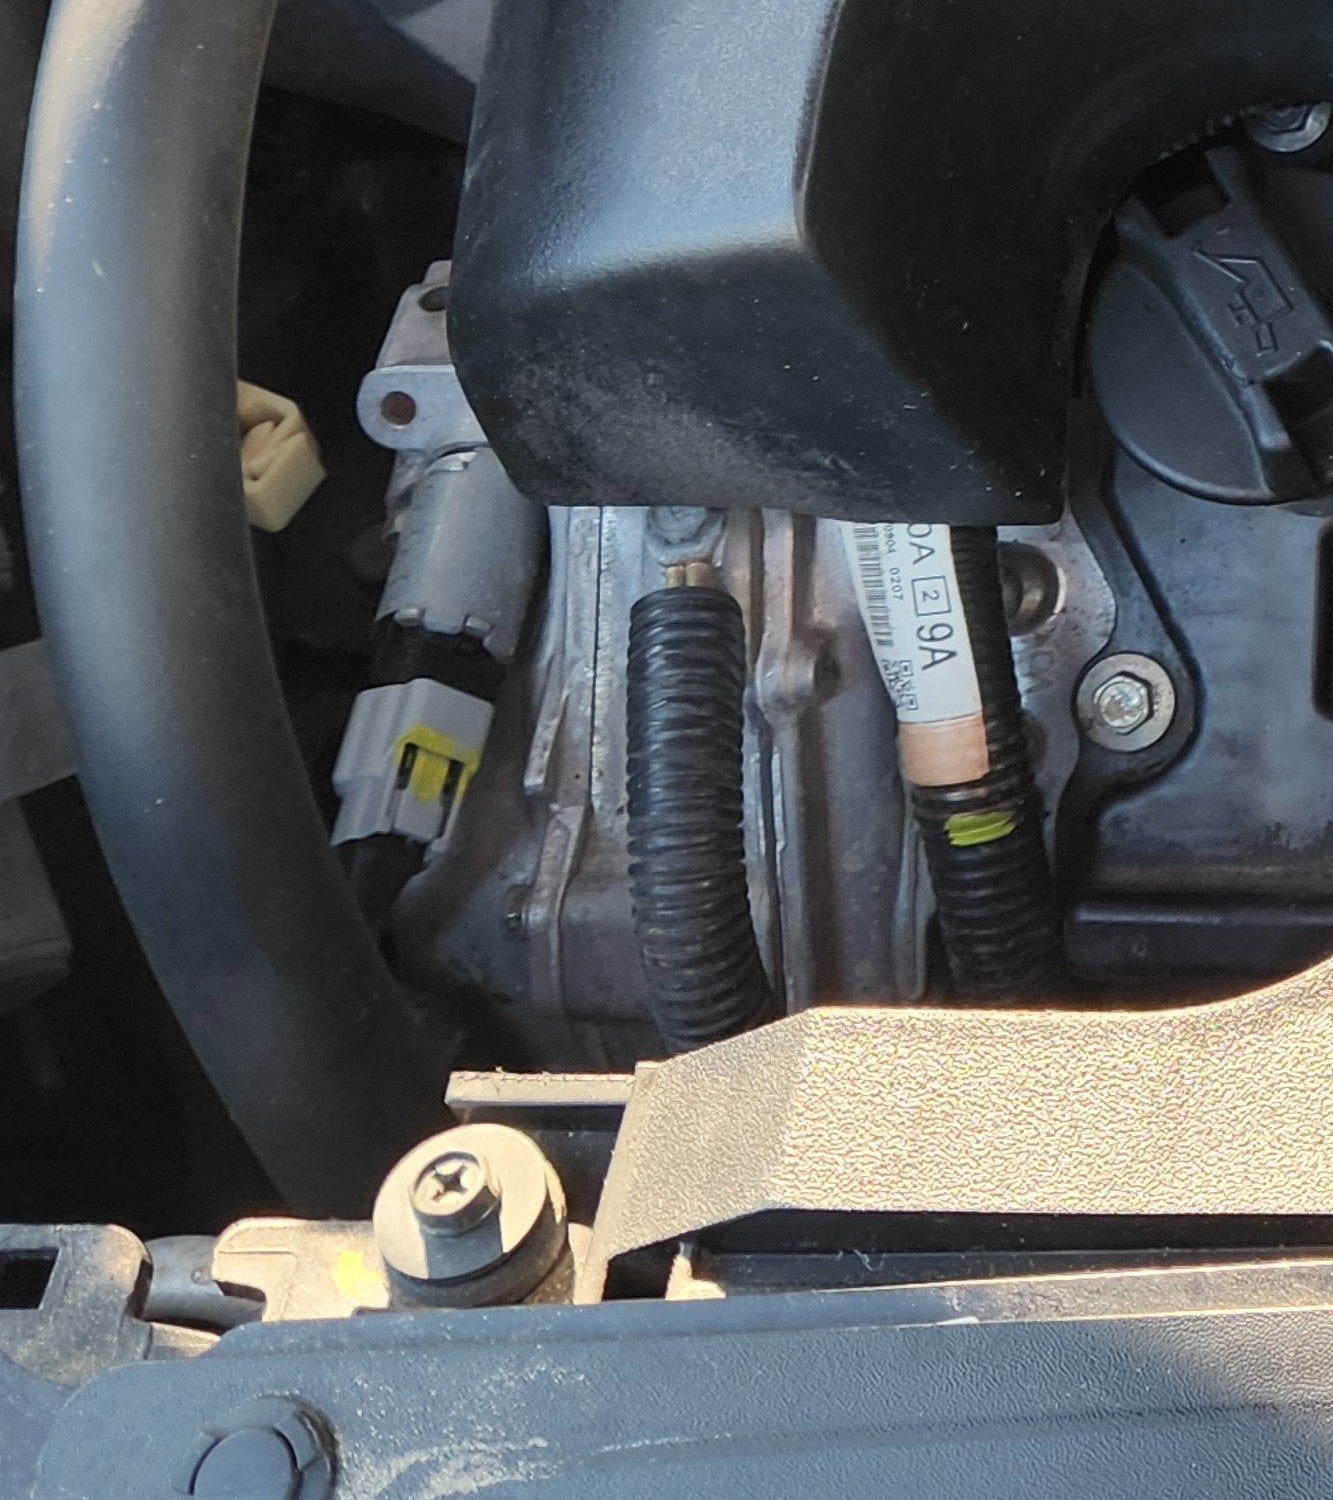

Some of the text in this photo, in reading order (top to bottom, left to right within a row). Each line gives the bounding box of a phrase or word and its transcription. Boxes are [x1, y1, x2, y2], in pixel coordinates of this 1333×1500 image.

[889, 567, 904, 600] 0207
[922, 590, 940, 602] 2
[916, 623, 957, 671] 9A
